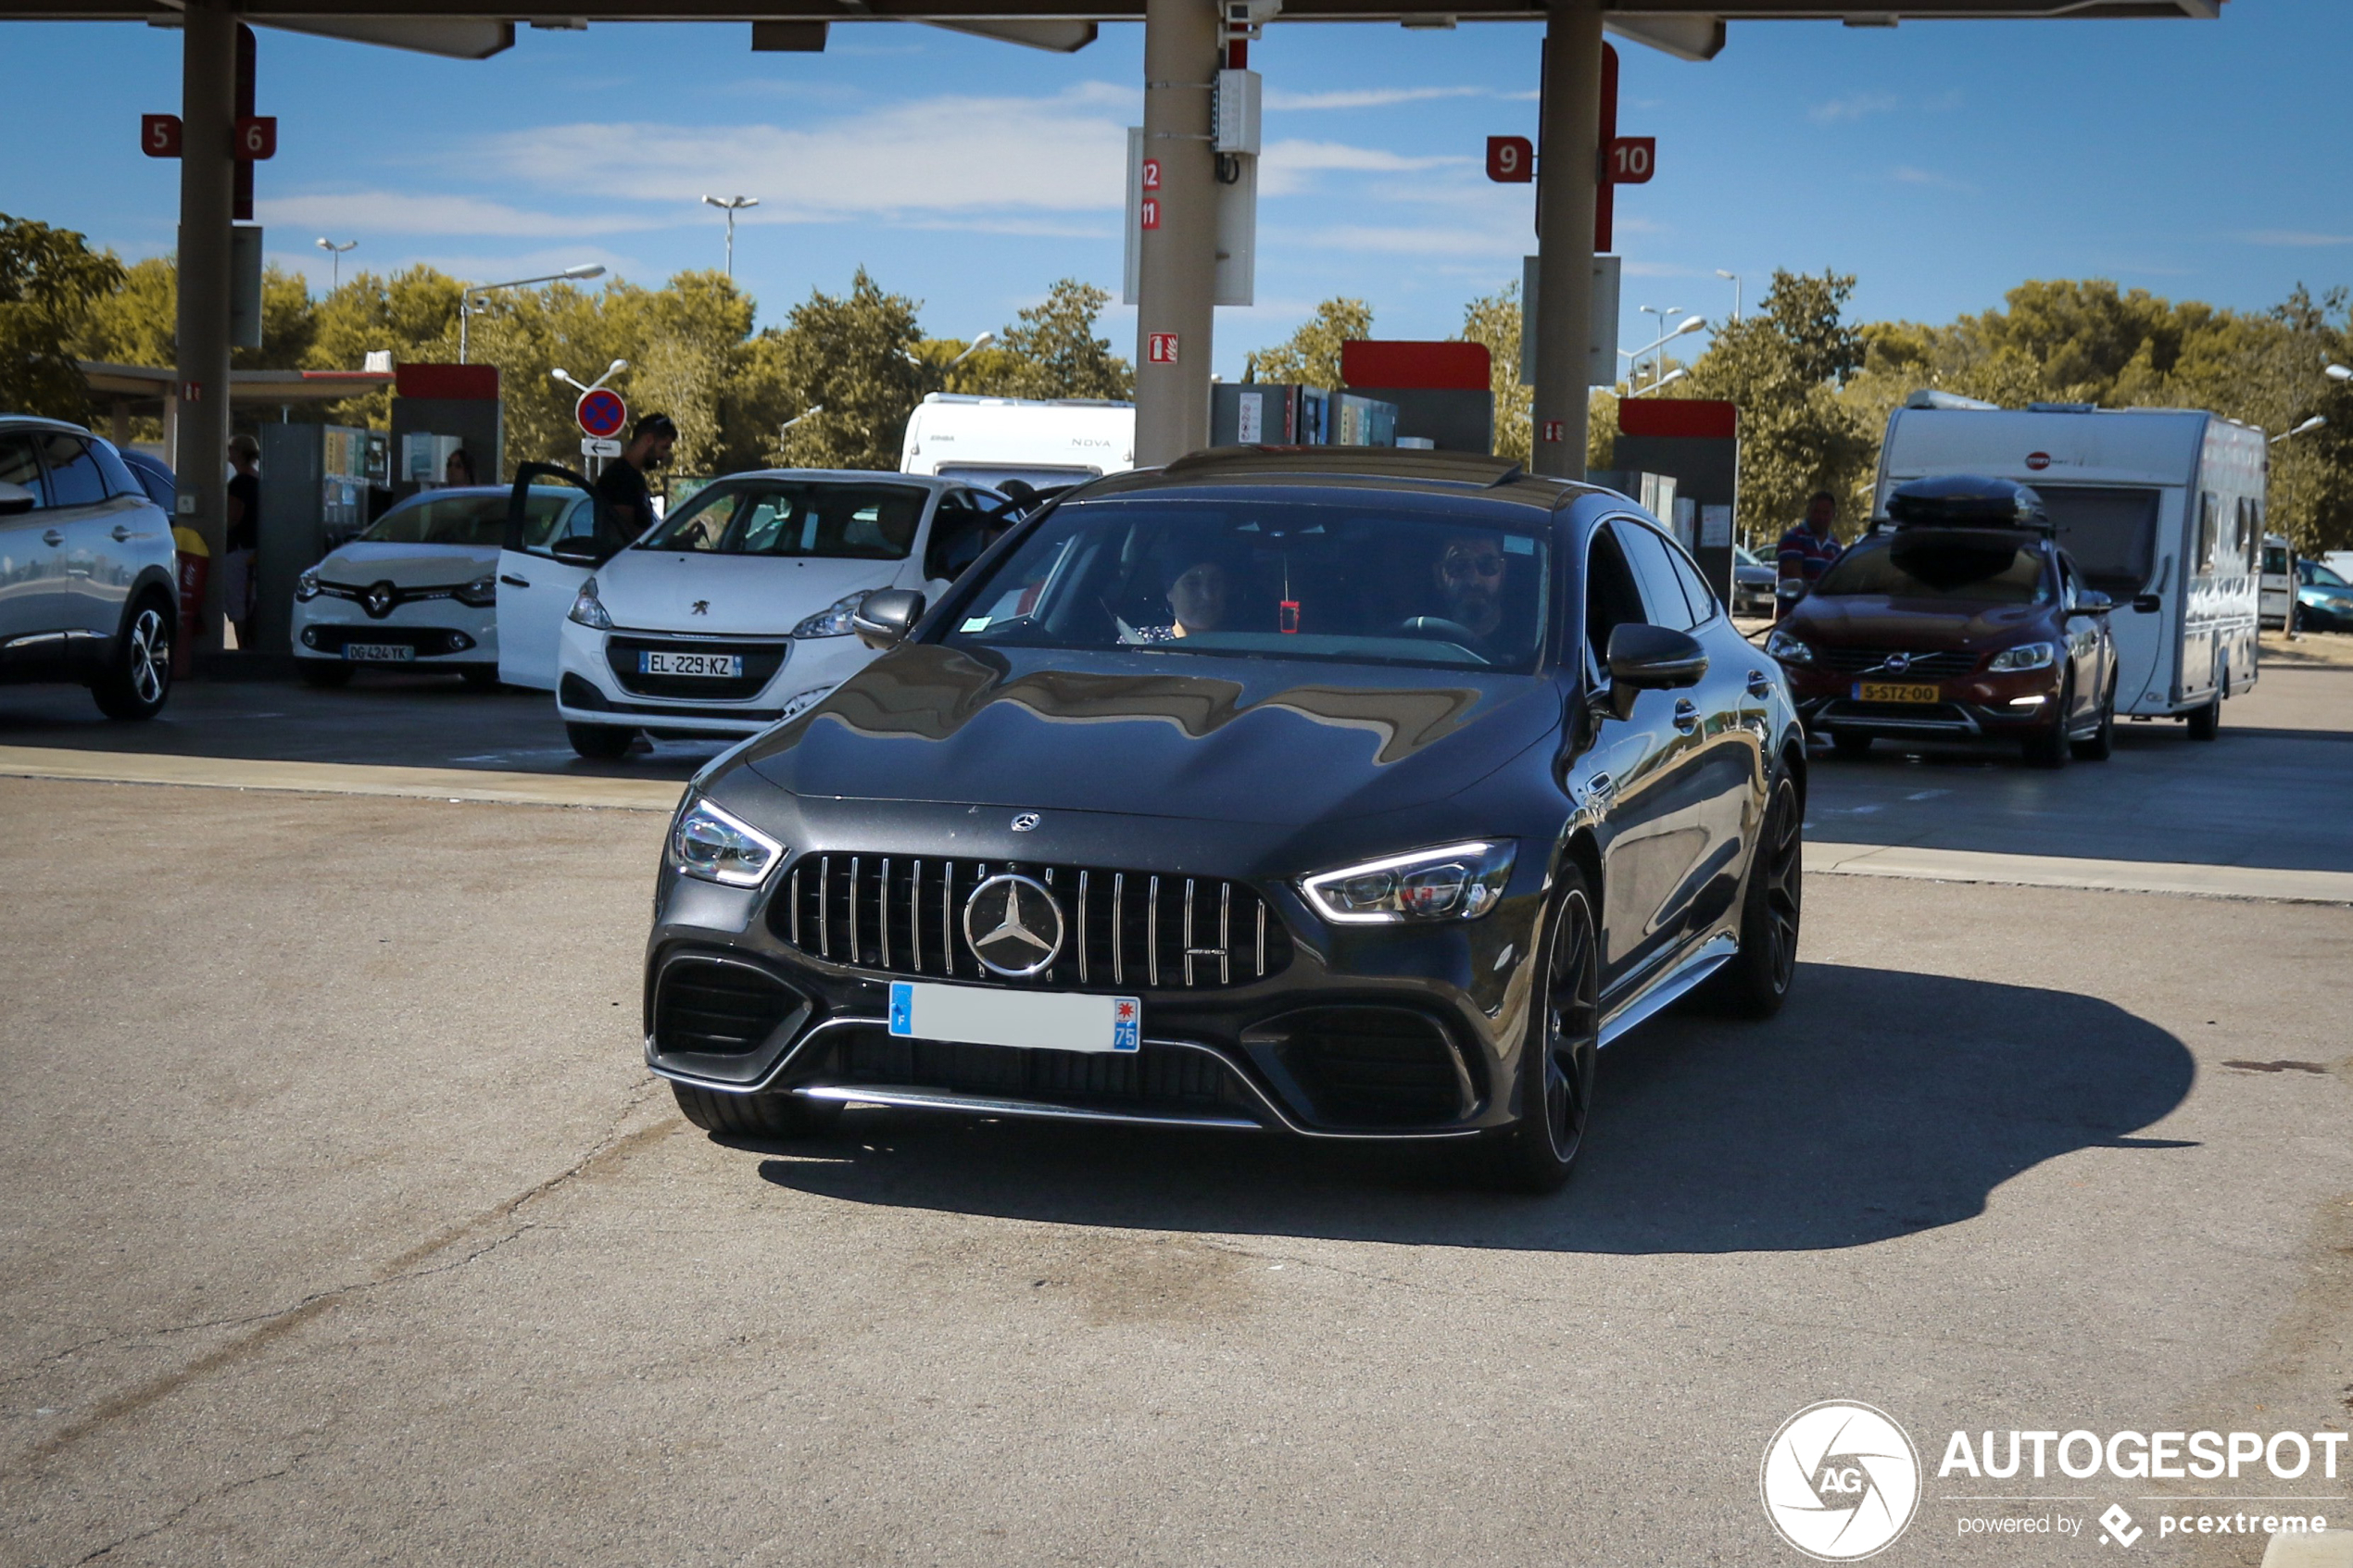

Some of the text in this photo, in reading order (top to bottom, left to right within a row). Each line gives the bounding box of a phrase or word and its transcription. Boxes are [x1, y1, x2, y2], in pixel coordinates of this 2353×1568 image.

[153, 123, 169, 148] 5
[246, 125, 263, 151] 6
[1500, 144, 1518, 173] 9
[1615, 145, 1648, 174] 10
[1143, 163, 1158, 185] 12
[1142, 203, 1155, 224] 11
[897, 1015, 906, 1026] F
[1115, 1026, 1135, 1047] 75
